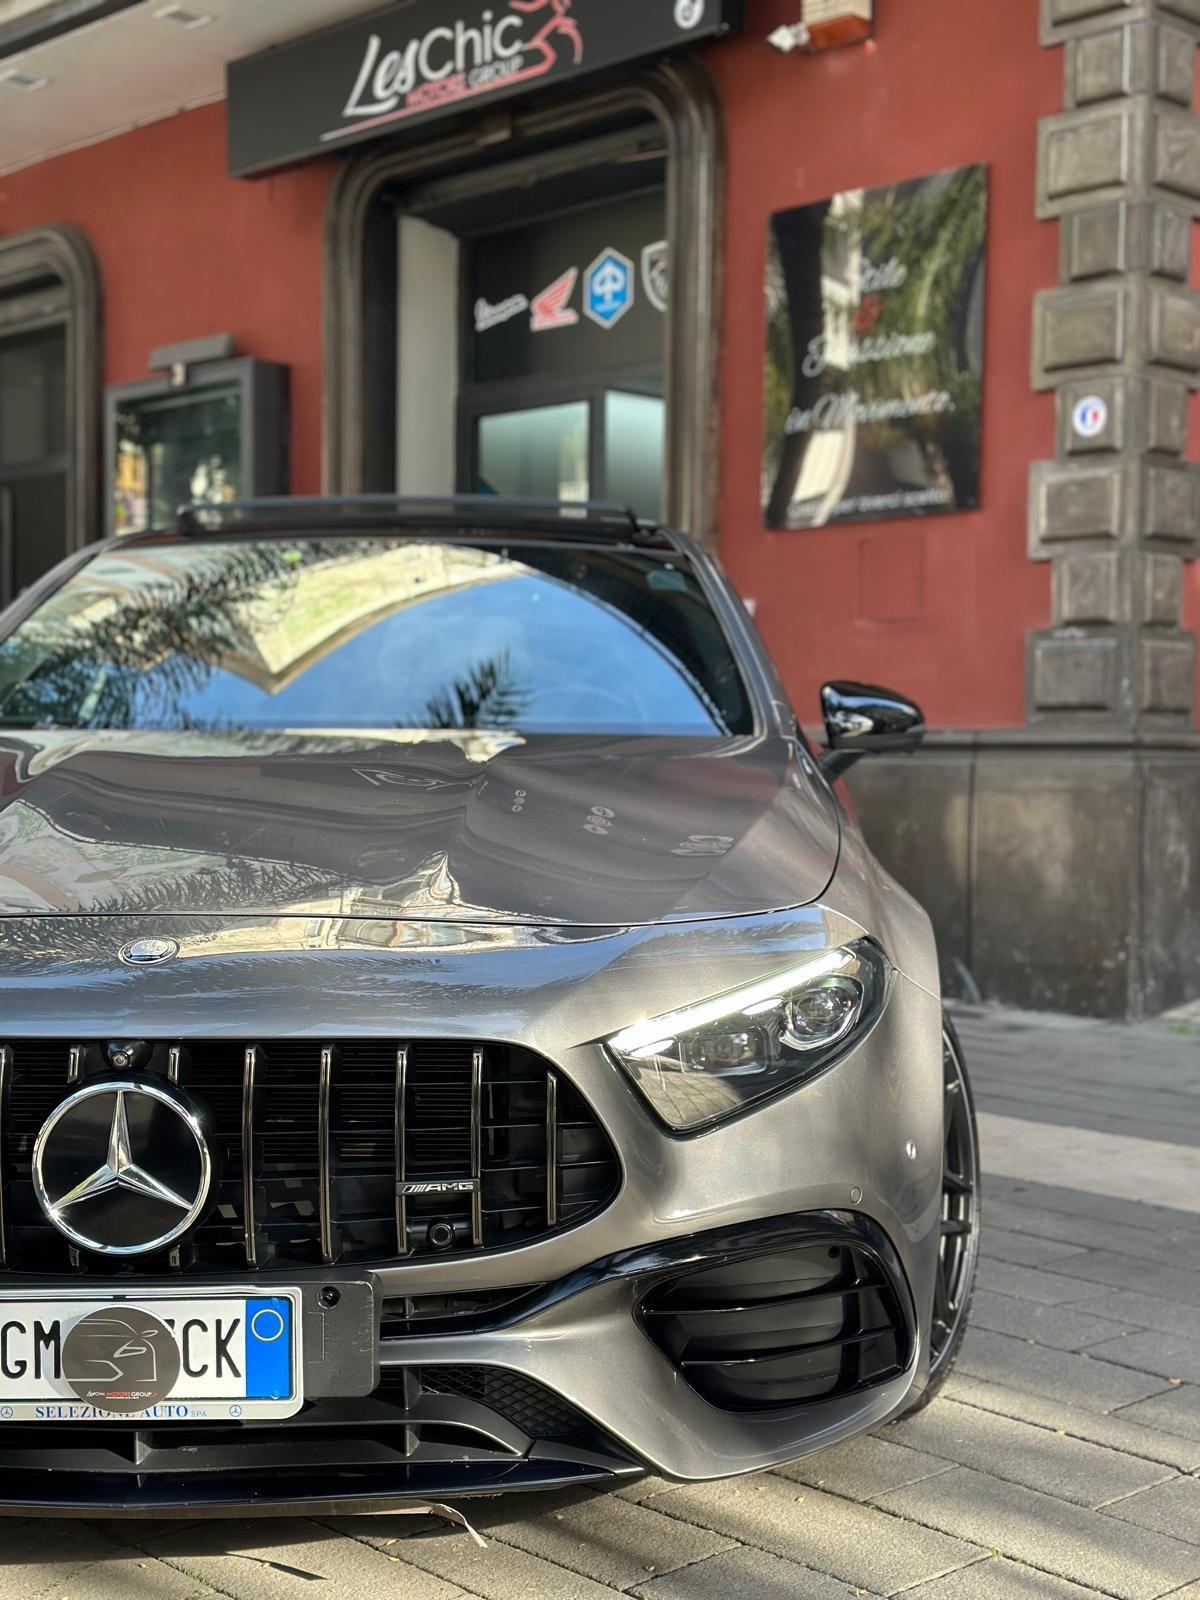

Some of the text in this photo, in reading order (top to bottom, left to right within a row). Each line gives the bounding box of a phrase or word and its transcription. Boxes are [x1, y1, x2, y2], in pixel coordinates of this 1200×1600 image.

[342, 9, 523, 117] LesChic
[468, 54, 524, 88] GROUP
[425, 1182, 473, 1192] AMG
[1, 1319, 242, 1379] GMCK
